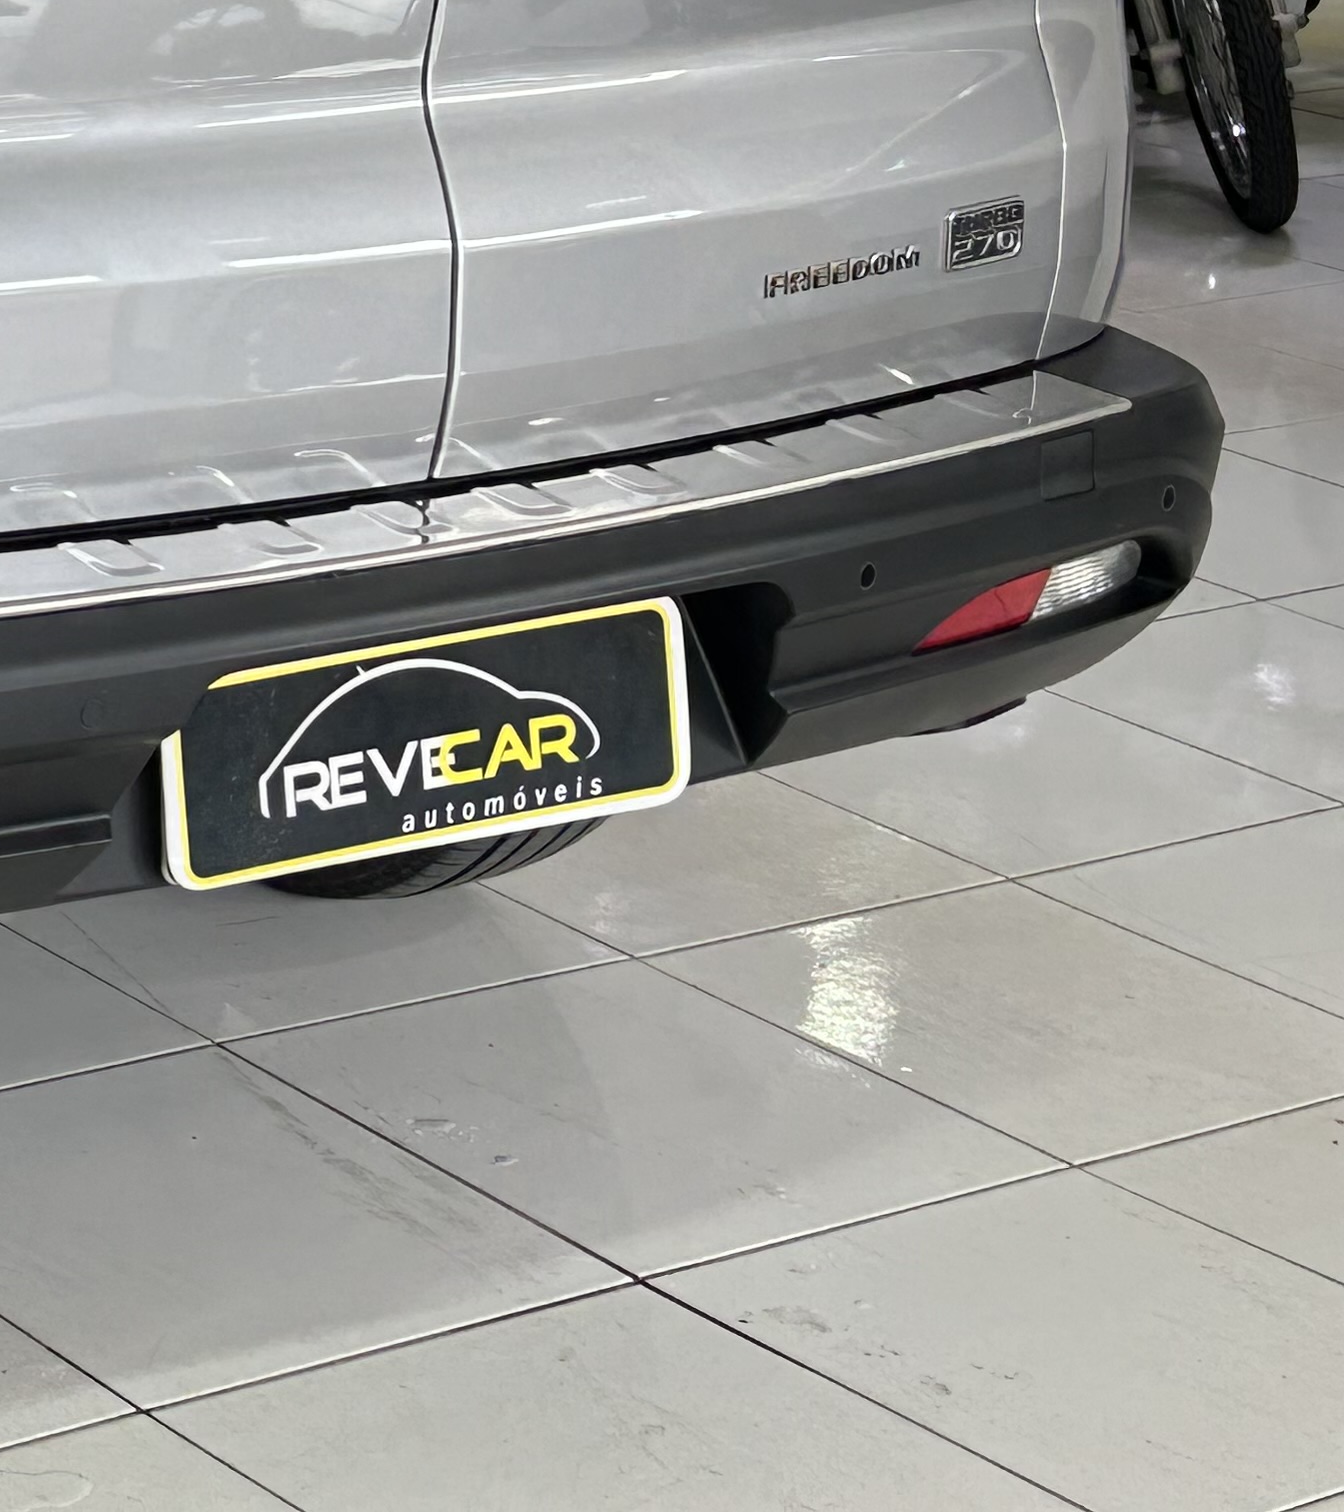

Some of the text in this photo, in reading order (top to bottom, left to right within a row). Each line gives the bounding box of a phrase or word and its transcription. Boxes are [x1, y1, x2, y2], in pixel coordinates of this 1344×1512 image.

[763, 244, 920, 298] FREEDOM
[952, 229, 1015, 262] 270
[283, 711, 580, 818] REVECAR
[400, 773, 604, 833] automóveis
